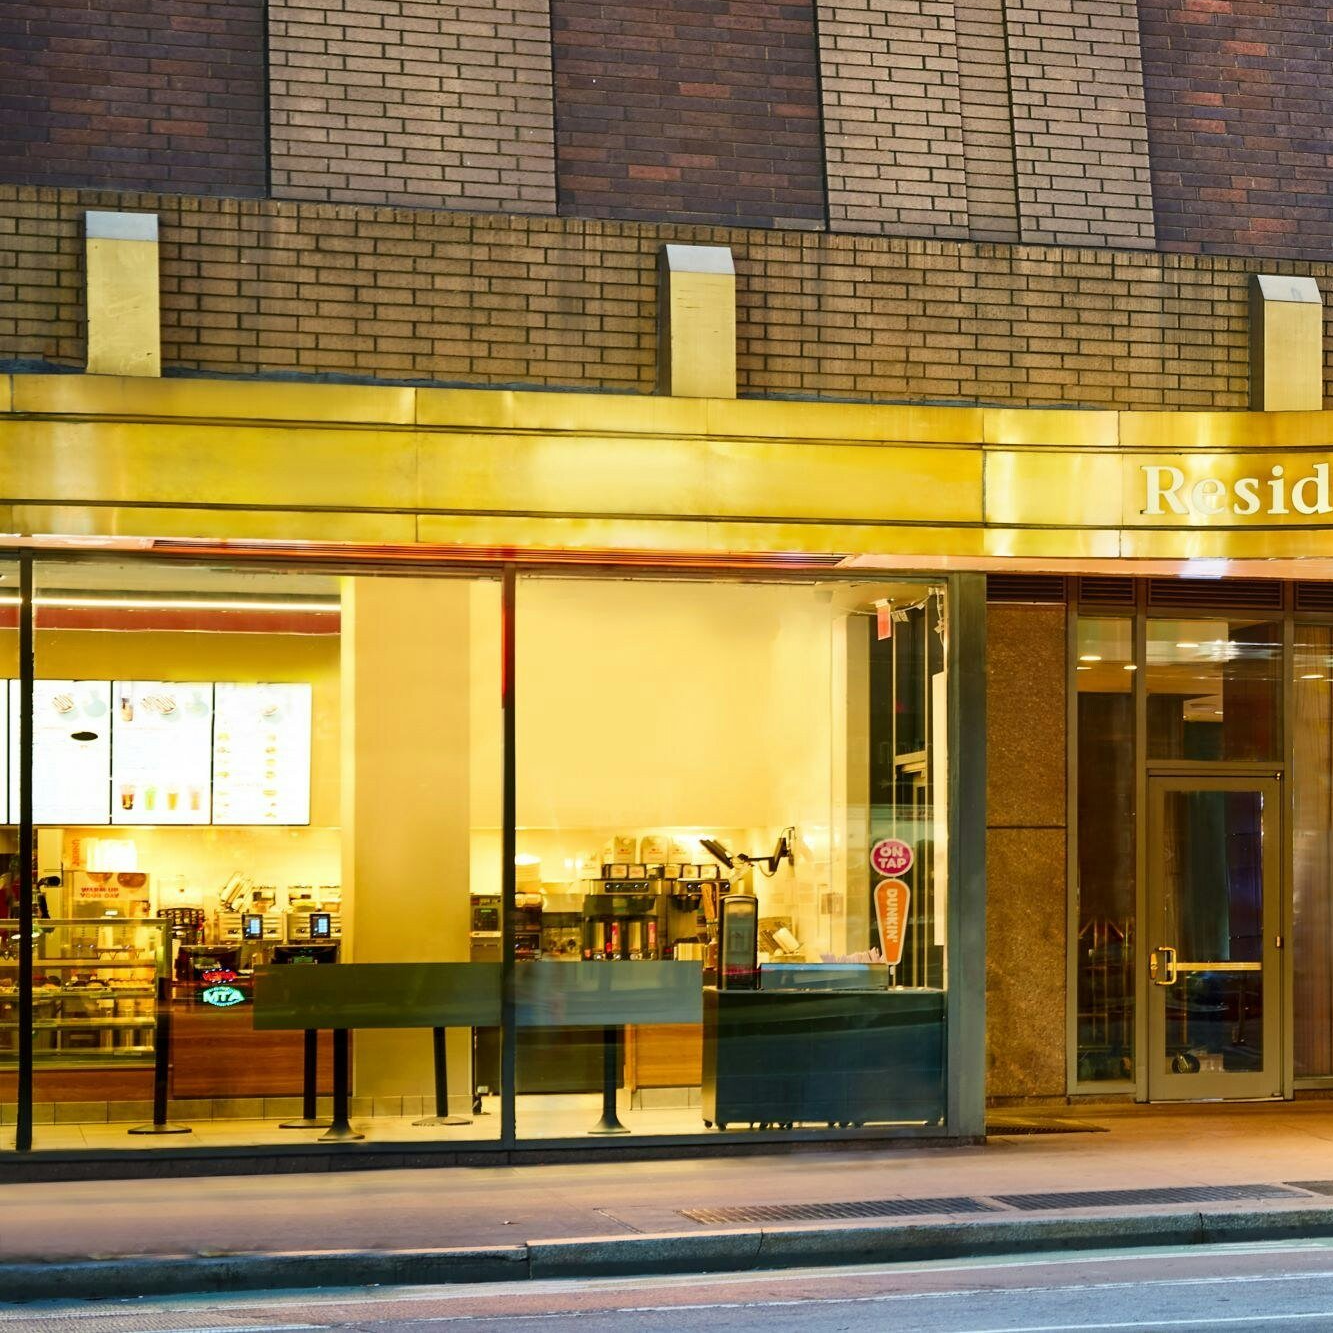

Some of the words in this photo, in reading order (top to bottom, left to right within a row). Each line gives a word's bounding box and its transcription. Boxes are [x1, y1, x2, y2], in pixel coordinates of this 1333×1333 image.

[879, 846, 904, 858] ON
[877, 857, 907, 869] TAP
[886, 888, 899, 943] DUNKIN'
[203, 989, 246, 1003] MTA
